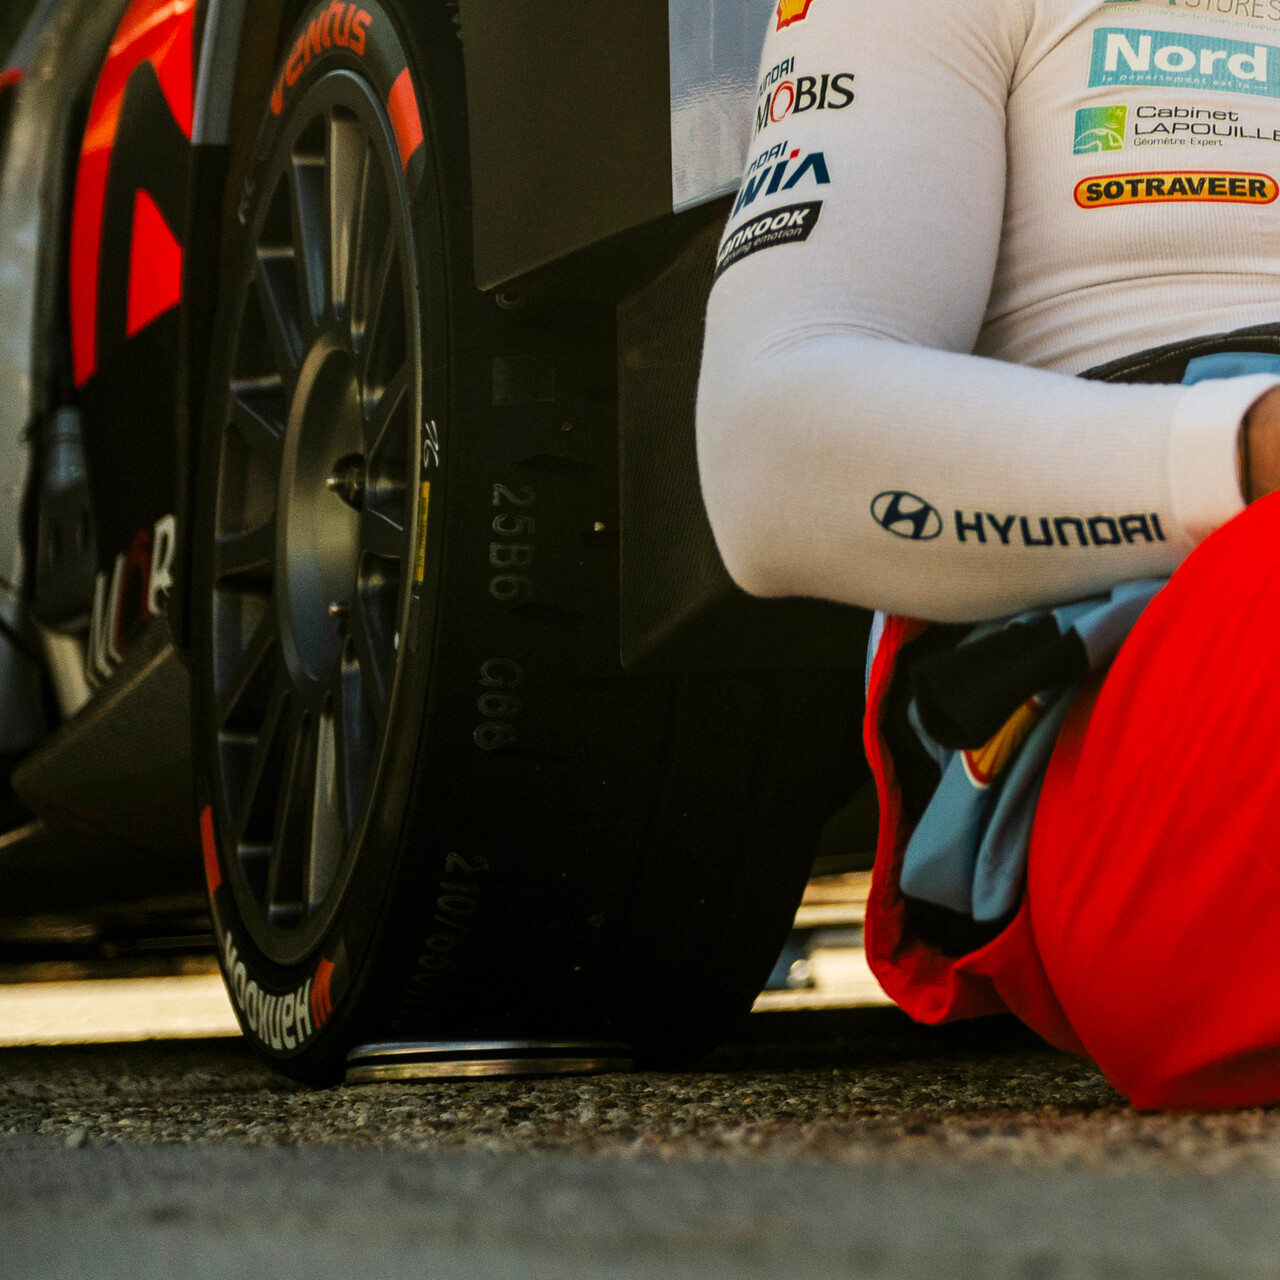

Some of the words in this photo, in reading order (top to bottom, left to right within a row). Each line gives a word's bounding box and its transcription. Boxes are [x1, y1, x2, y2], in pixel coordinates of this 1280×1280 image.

[1103, 33, 1268, 82] Nord
[1136, 105, 1239, 121] Cabinet
[1086, 176, 1268, 202] SOTRAVEER
[954, 509, 1167, 547] HYUNDAI
